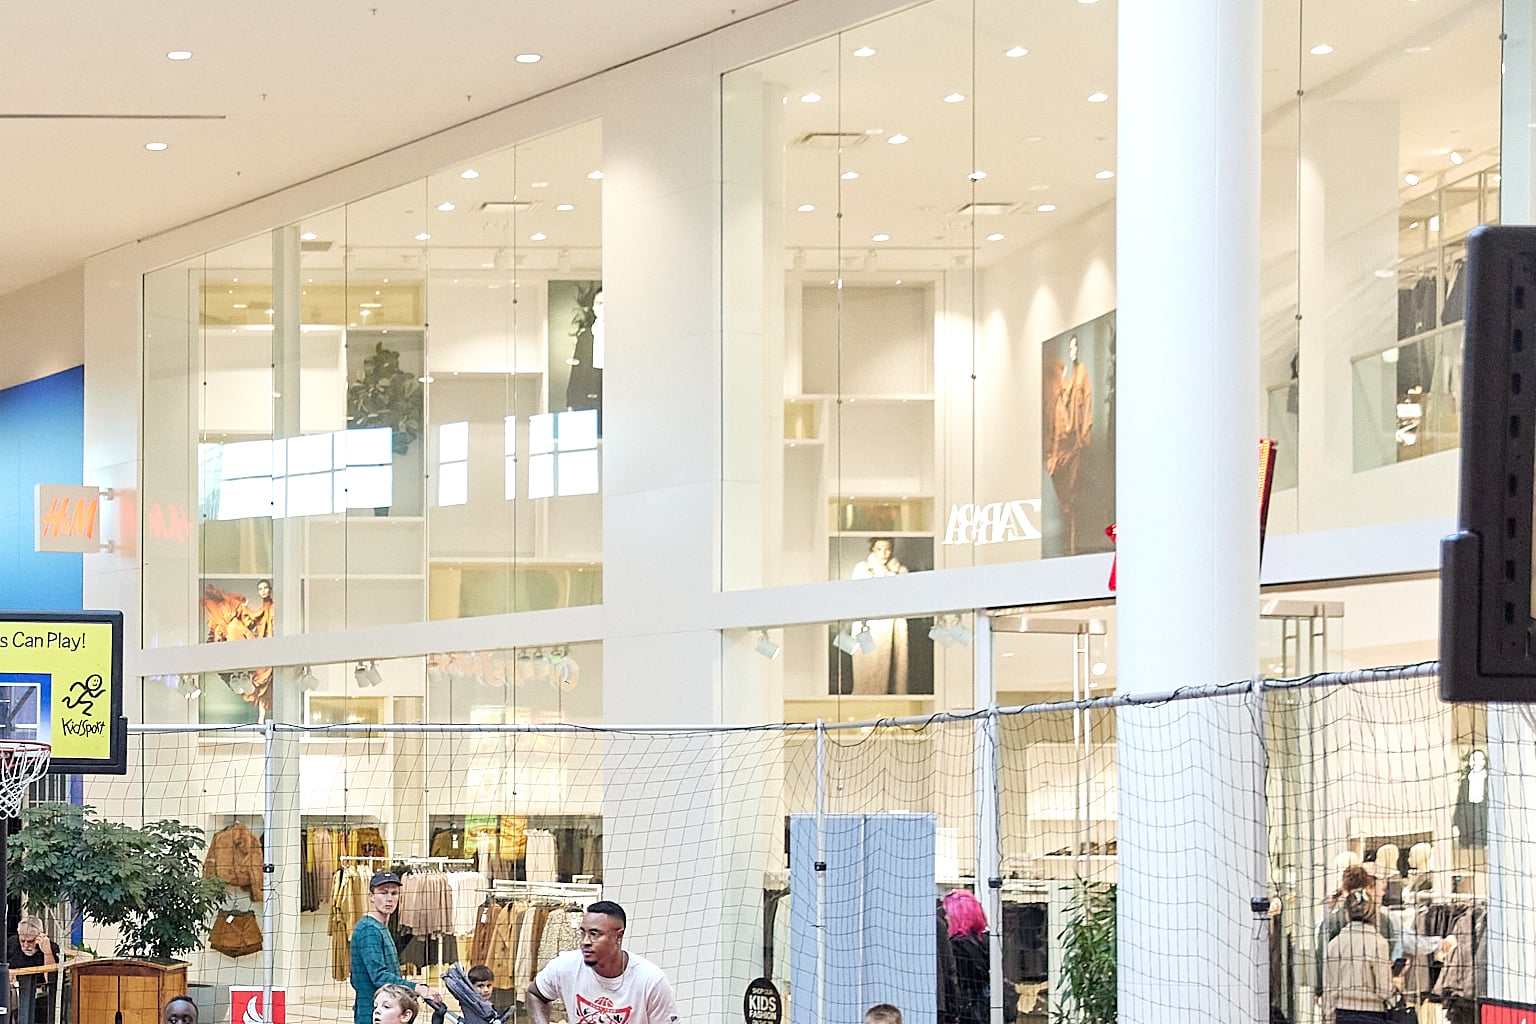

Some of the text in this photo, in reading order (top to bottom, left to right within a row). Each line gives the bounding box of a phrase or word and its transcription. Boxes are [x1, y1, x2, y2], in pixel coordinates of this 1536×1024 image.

[43, 497, 99, 540] H&M
[12, 631, 44, 648] Can
[47, 632, 86, 652] Play!
[61, 717, 106, 738] KidSport
[748, 994, 777, 1012] KIDS
